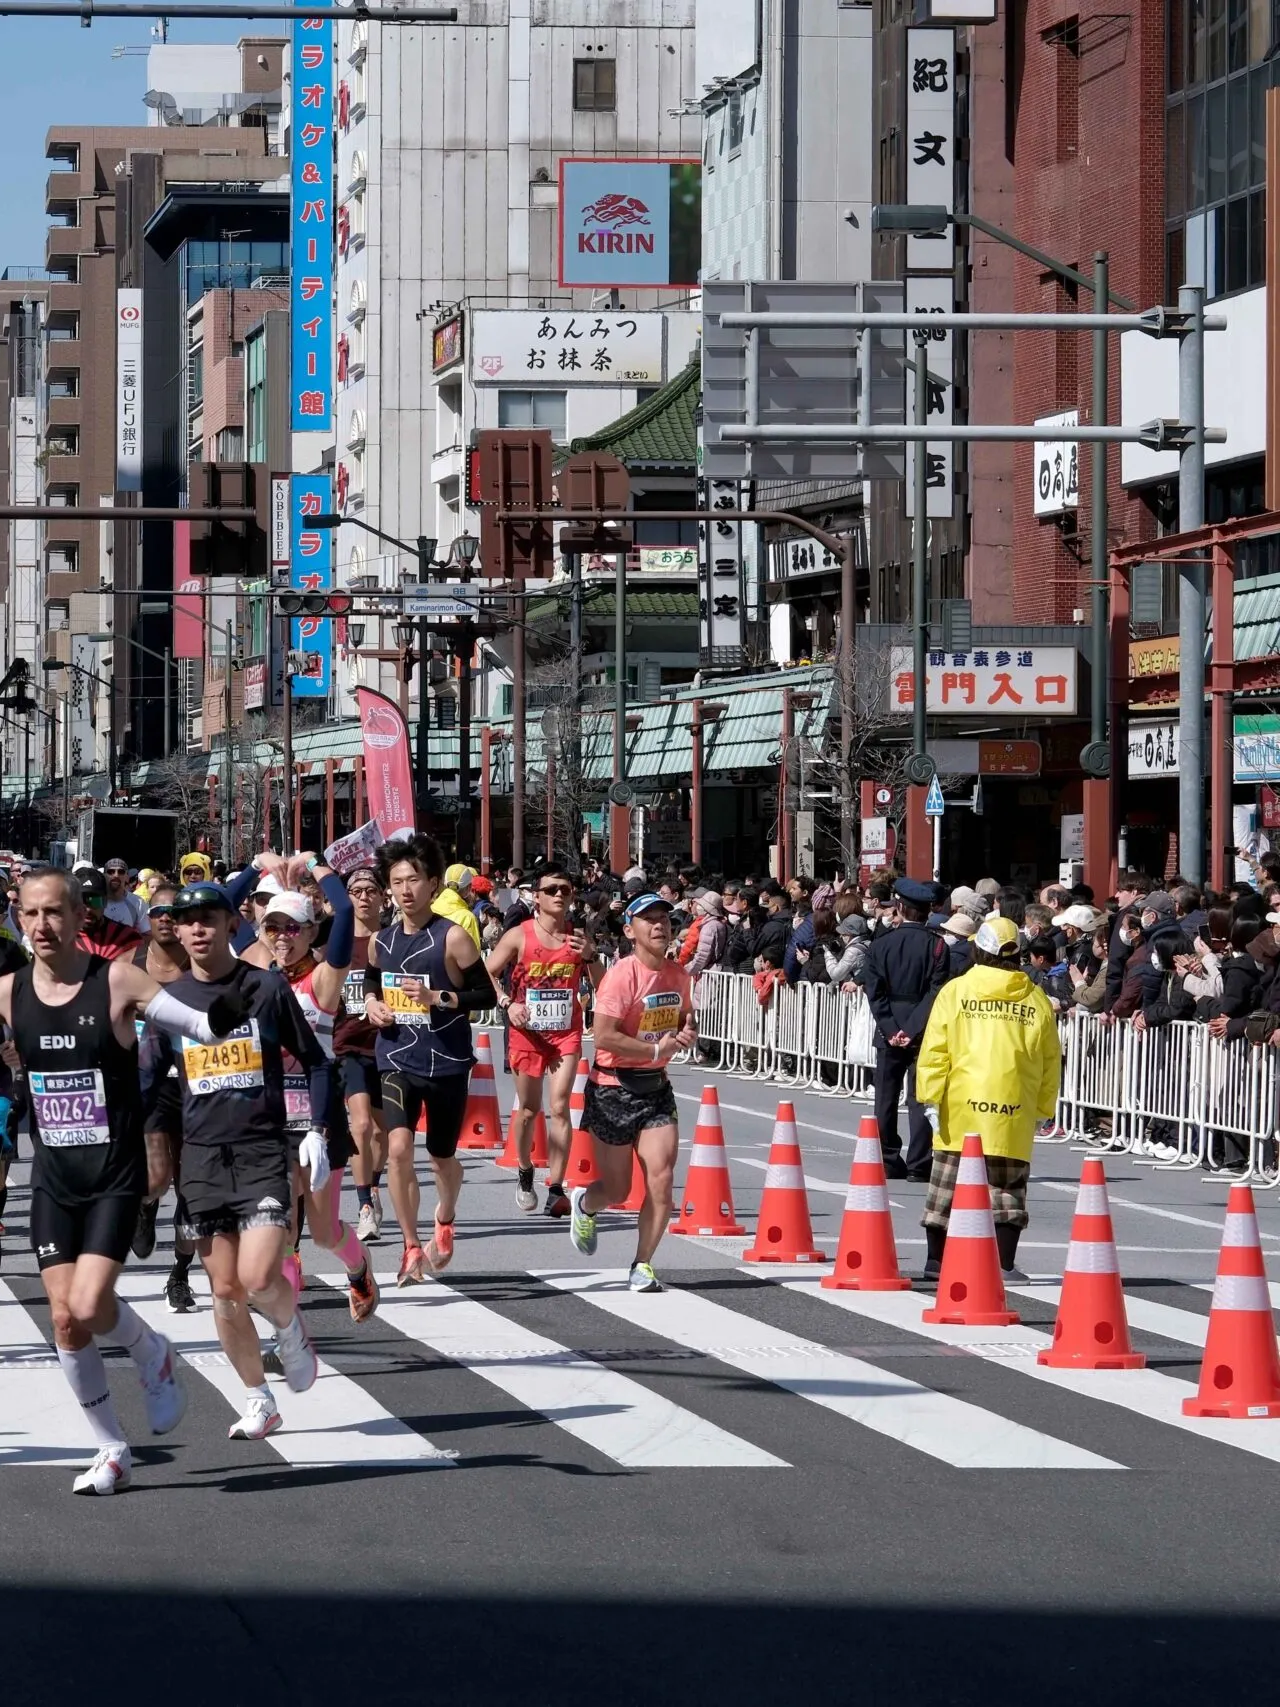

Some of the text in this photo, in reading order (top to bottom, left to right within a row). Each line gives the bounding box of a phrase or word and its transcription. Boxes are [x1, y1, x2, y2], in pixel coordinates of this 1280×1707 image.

[577, 232, 655, 254] KIRIN
[537, 316, 638, 340] あんみつ
[481, 357, 501, 371] 2F
[526, 347, 613, 372] お抹茶
[122, 359, 137, 456] 三菱UFJ銀行
[1039, 444, 1079, 500] 日高屋
[179, 580, 201, 592] JTB
[409, 603, 472, 612] Kaminarimon Gate
[929, 651, 1034, 668] 観音表参道
[895, 672, 1068, 705] 雷門入口
[1145, 724, 1177, 770] 日高屋
[541, 990, 572, 1000] 東京メトロ
[536, 1003, 567, 1017] 86110
[960, 999, 1036, 1019] VOLUNTEER
[960, 1011, 1035, 1027] TOKYO MARATHON
[39, 1036, 76, 1049] EDU
[201, 1043, 250, 1070] 24891
[46, 1076, 92, 1089] 東京メトロ
[42, 1096, 95, 1122] 60262
